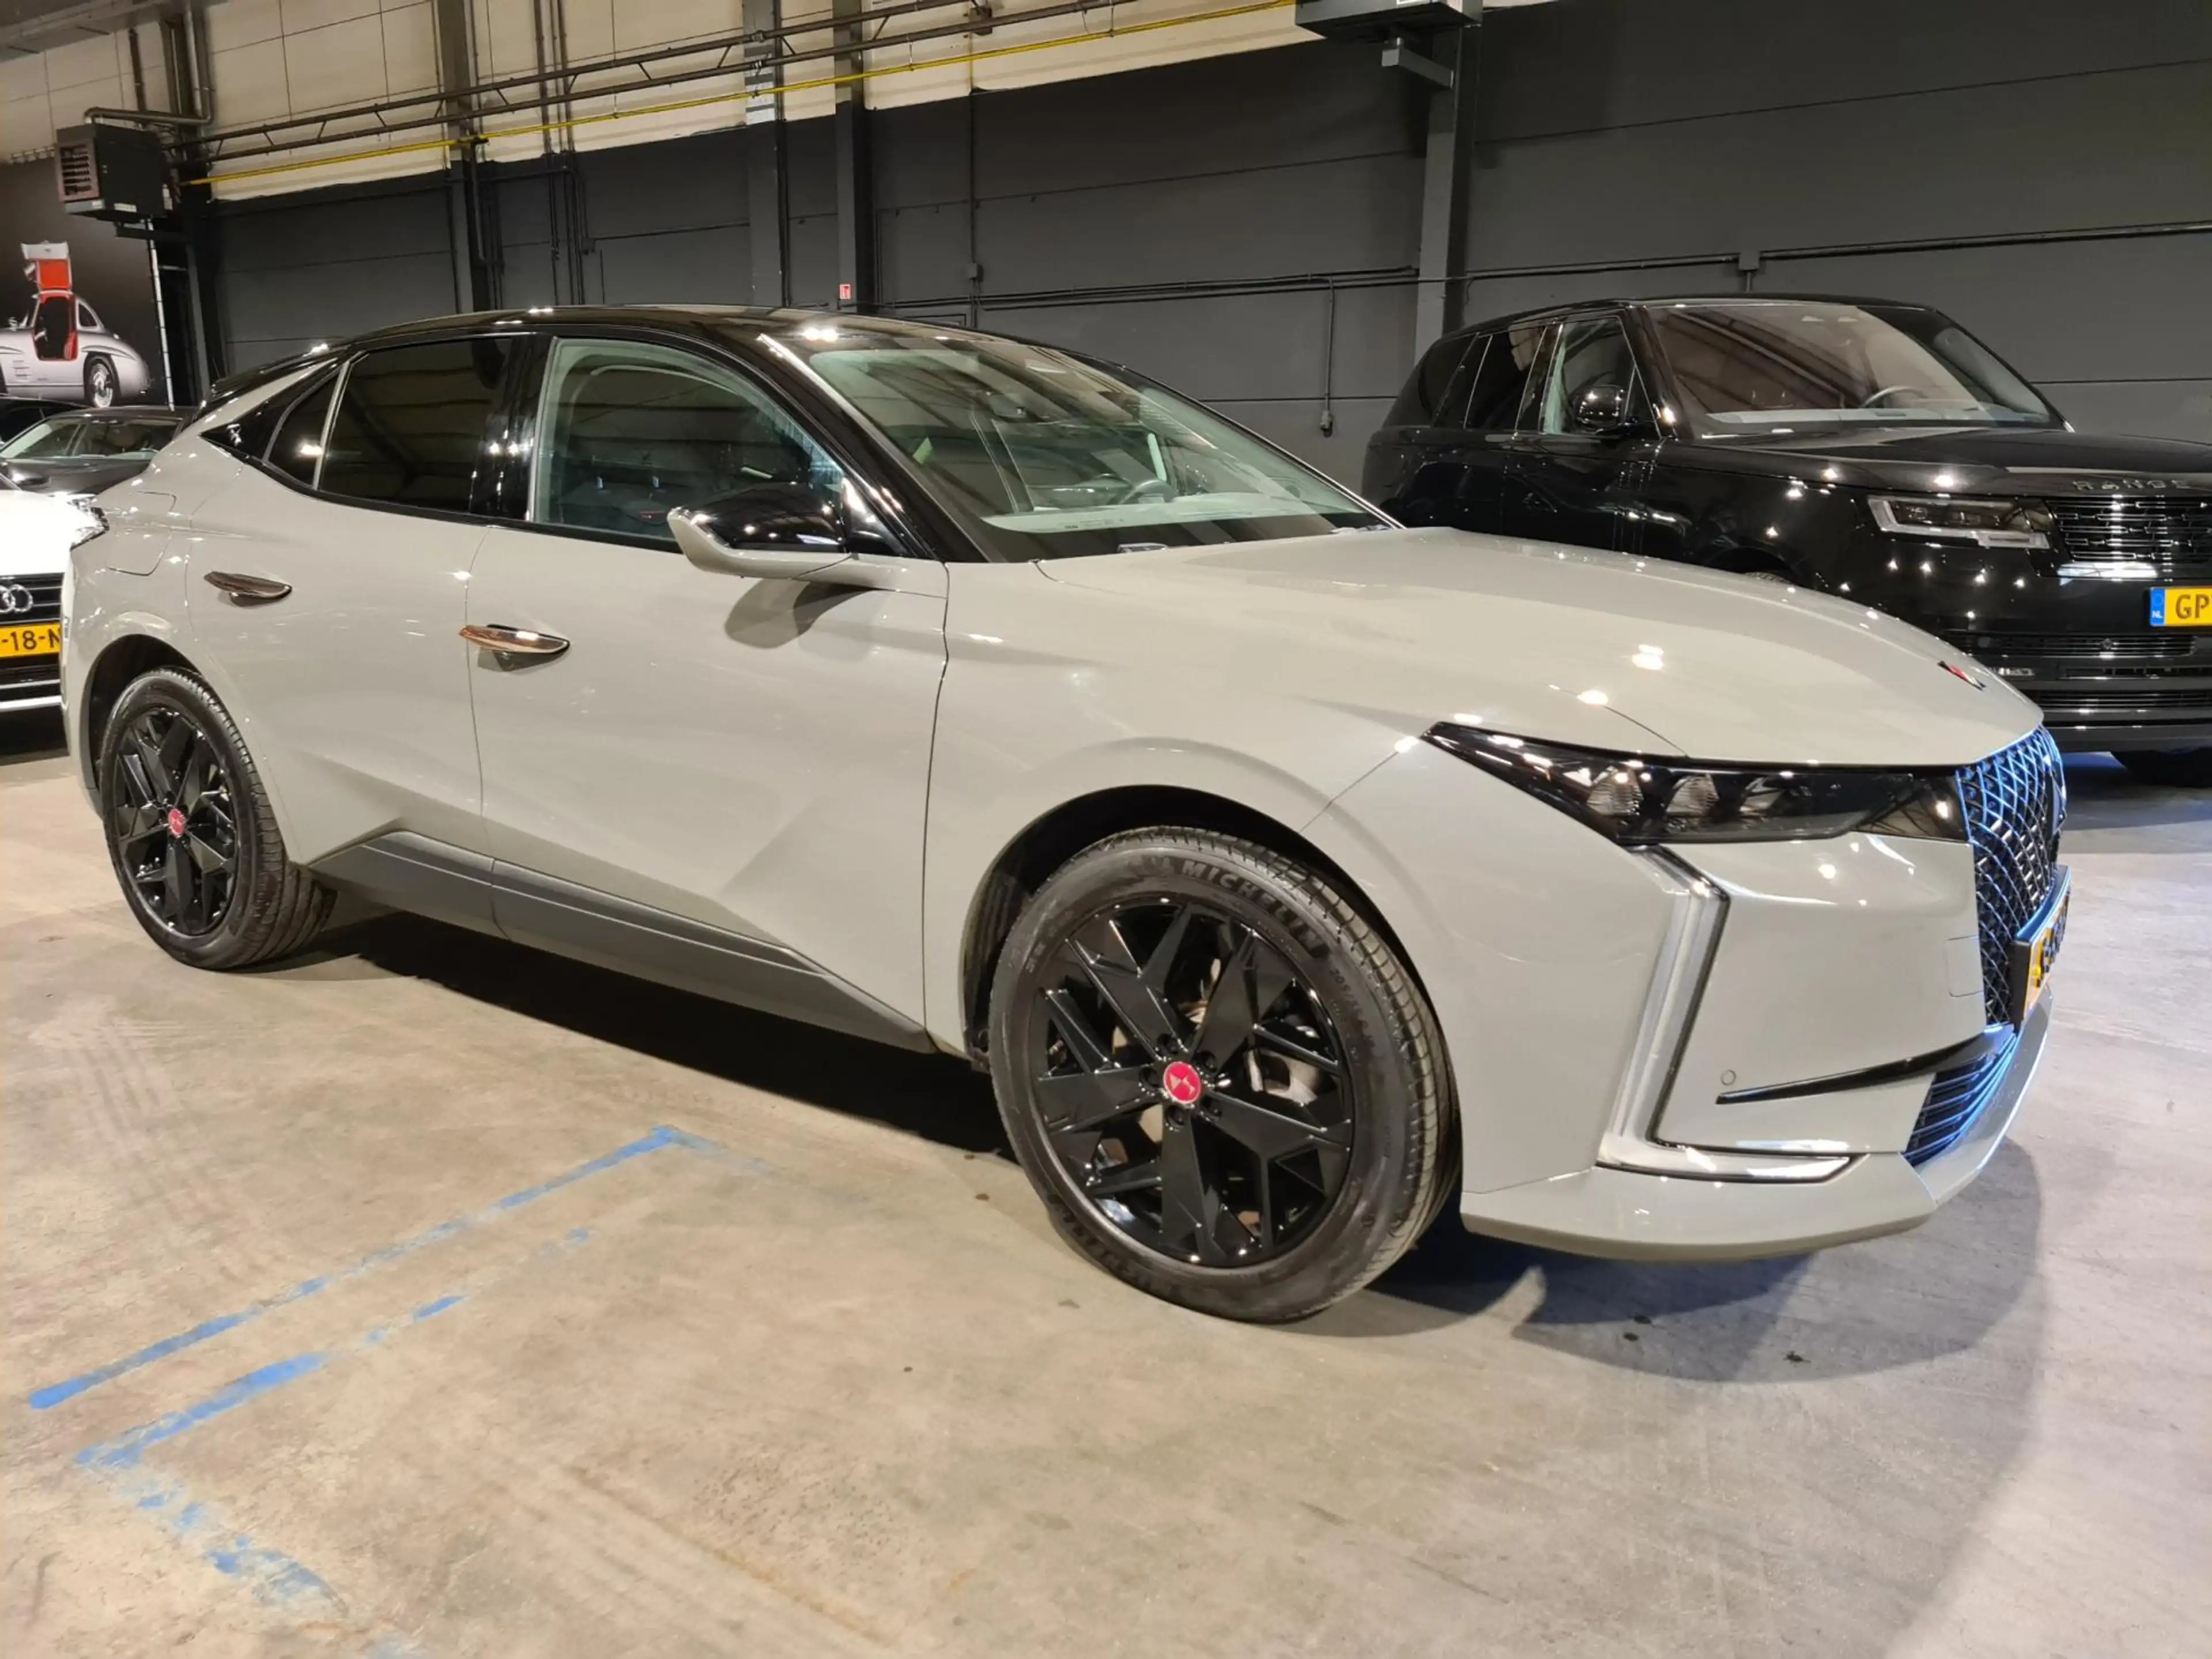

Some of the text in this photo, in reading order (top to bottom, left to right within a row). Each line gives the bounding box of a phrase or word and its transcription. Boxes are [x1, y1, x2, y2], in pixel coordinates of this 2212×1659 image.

[2072, 479, 2191, 490] RANGE
[2152, 610, 2164, 618] NL
[2175, 593, 2212, 620] GP
[1181, 859, 1324, 950] MICHELIN
